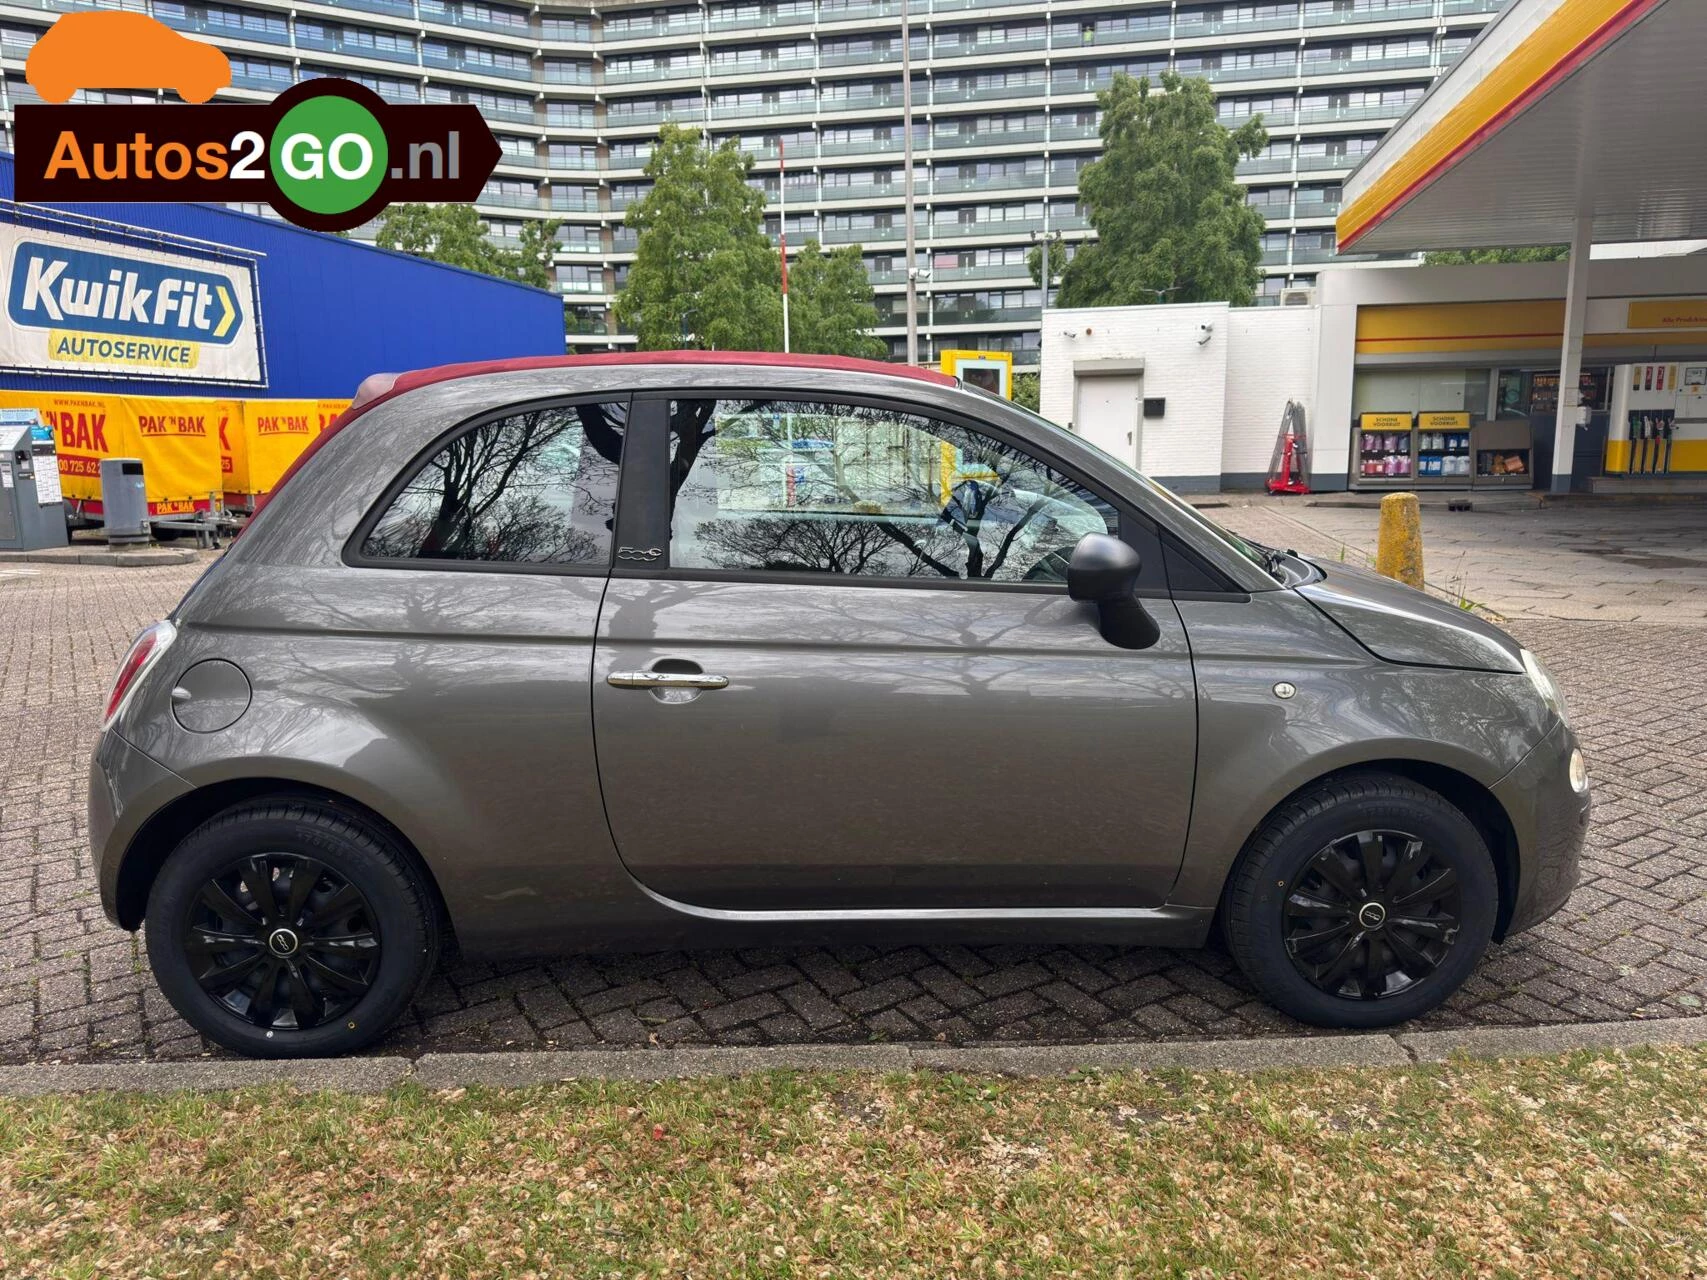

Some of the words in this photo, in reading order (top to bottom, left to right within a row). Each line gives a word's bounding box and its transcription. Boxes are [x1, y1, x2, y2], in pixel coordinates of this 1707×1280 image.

[57, 336, 191, 363] AUTOSERVICE
[60, 412, 109, 453] BAK
[138, 415, 168, 433] PAK
[177, 416, 206, 433] BAK
[257, 416, 279, 432] PAK
[287, 416, 309, 431] BAK
[70, 460, 84, 472] 725
[156, 501, 173, 514] PAK
[178, 501, 195, 513] BAK
